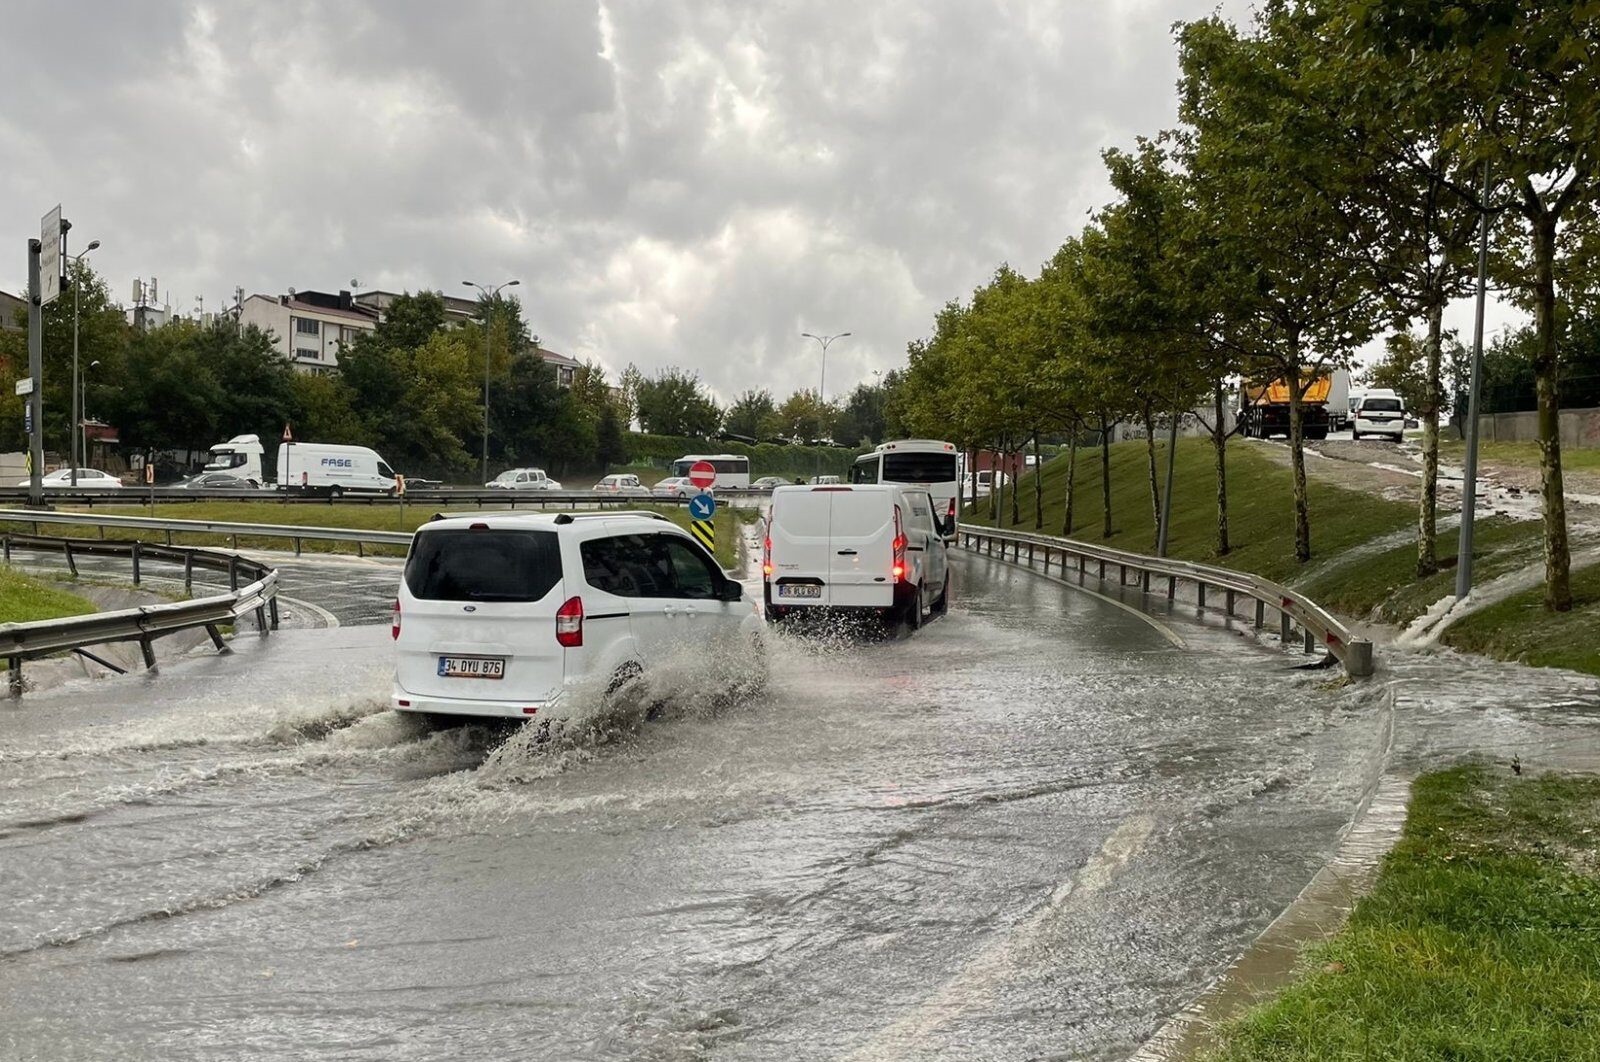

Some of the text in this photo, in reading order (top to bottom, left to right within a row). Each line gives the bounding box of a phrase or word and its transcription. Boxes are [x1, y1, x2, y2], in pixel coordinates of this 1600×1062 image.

[321, 458, 352, 467] FASE
[445, 659, 457, 672] 34
[482, 661, 501, 674] 876
